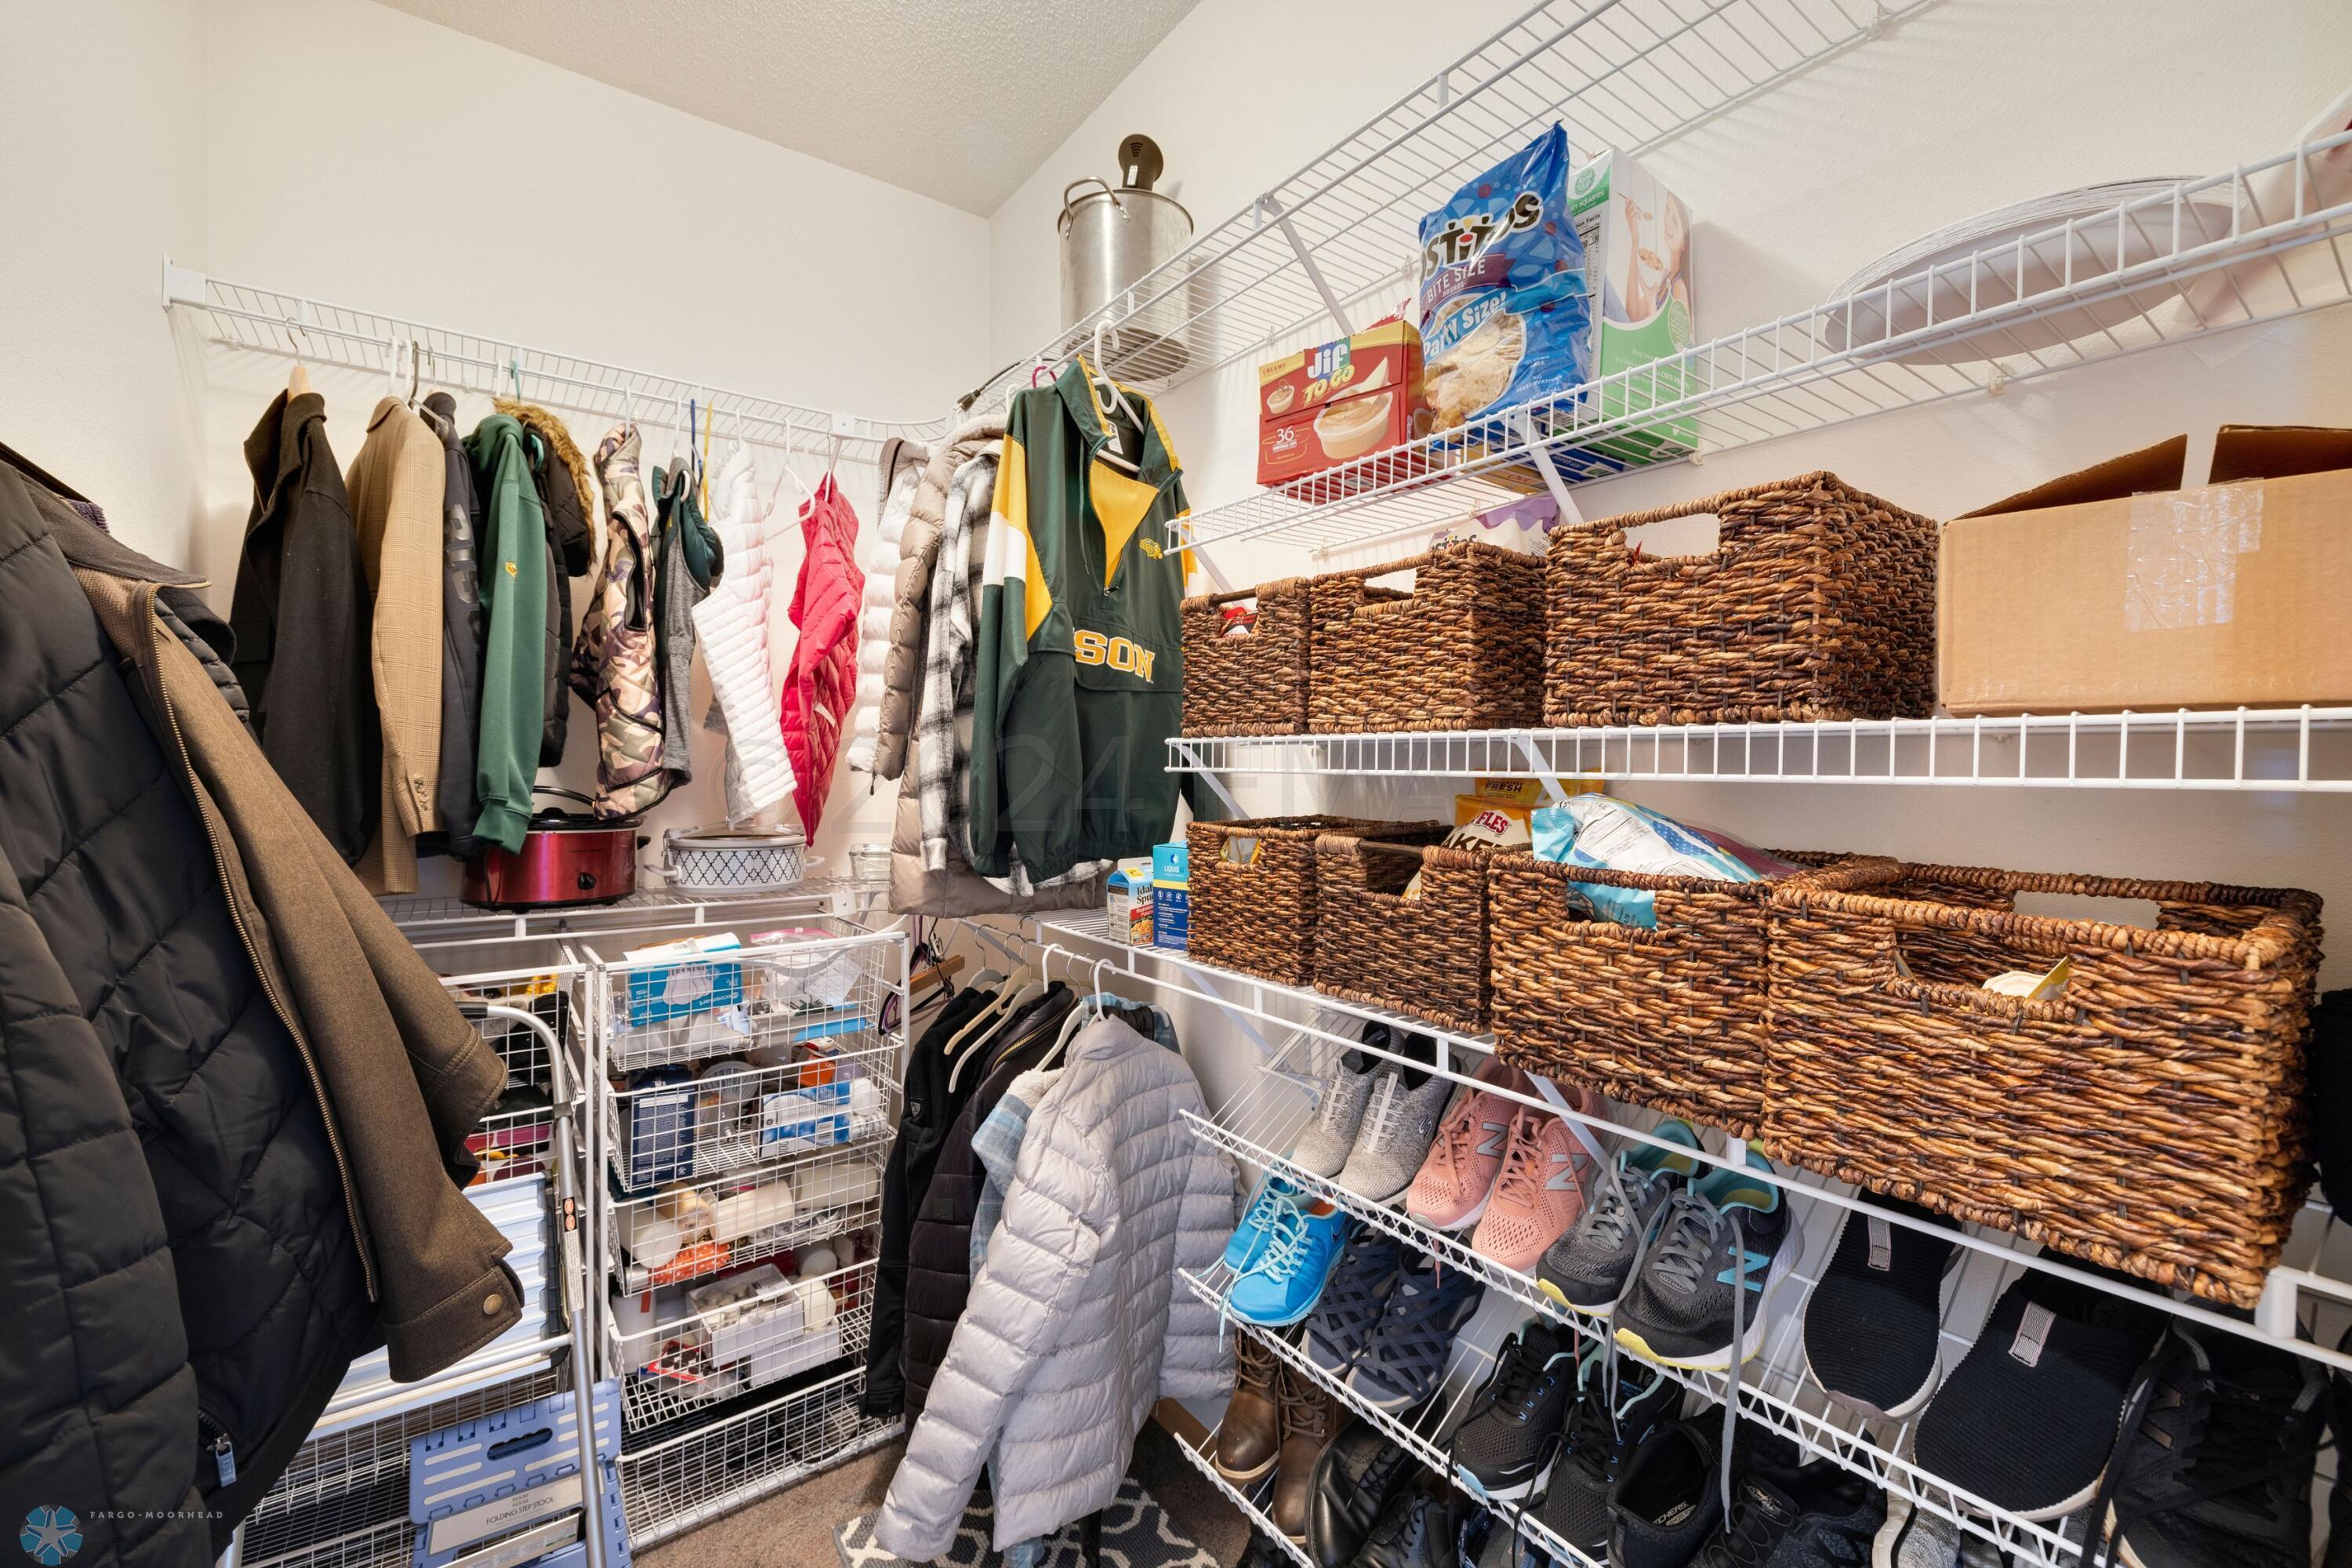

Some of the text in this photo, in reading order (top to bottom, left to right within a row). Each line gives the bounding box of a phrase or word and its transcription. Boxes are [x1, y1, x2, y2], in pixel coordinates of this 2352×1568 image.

[1427, 260, 1486, 303] BITE SIZE
[1424, 292, 1506, 359] Party Size!
[1263, 363, 1286, 374] CREAMY
[1307, 344, 1348, 379] Jif
[1304, 365, 1355, 407] TO GO
[1276, 426, 1294, 444] 36
[1073, 630, 1155, 683] SON
[1485, 782, 1523, 793] FRESH
[486, 1509, 517, 1524] FOLDING
[517, 1504, 532, 1514] STEP
